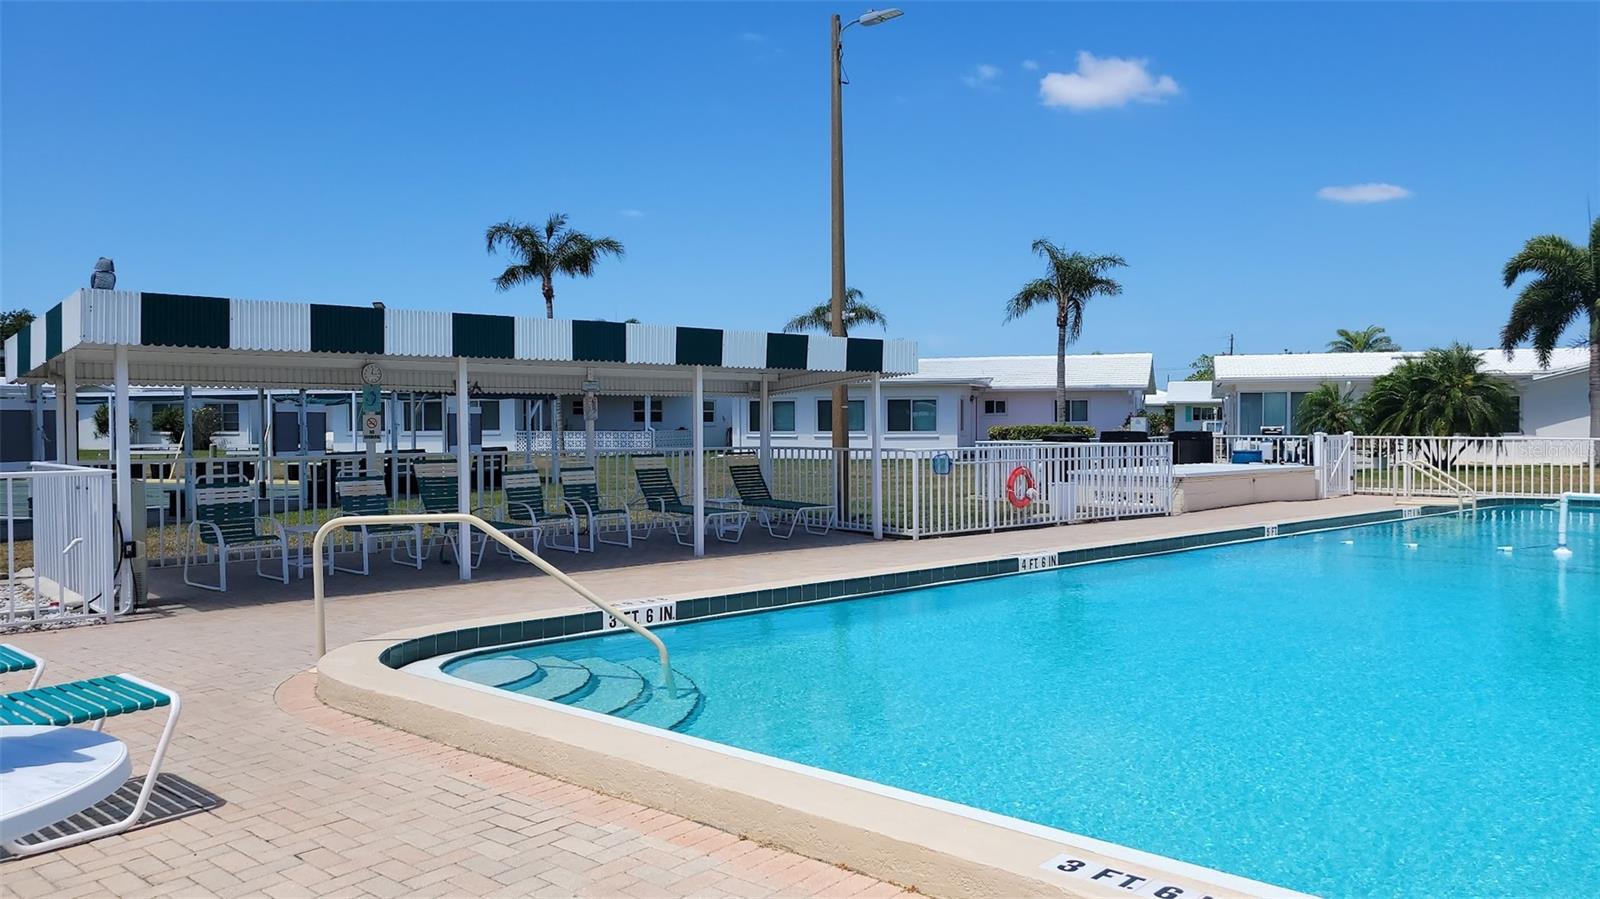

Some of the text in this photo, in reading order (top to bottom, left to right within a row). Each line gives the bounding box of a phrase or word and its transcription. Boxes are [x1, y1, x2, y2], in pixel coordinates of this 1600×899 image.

[1021, 559, 1026, 571] 4
[1041, 556, 1046, 568] 6
[646, 608, 653, 623] 6
[659, 605, 675, 622] IN.
[1056, 859, 1184, 899] 3 FT. 6
